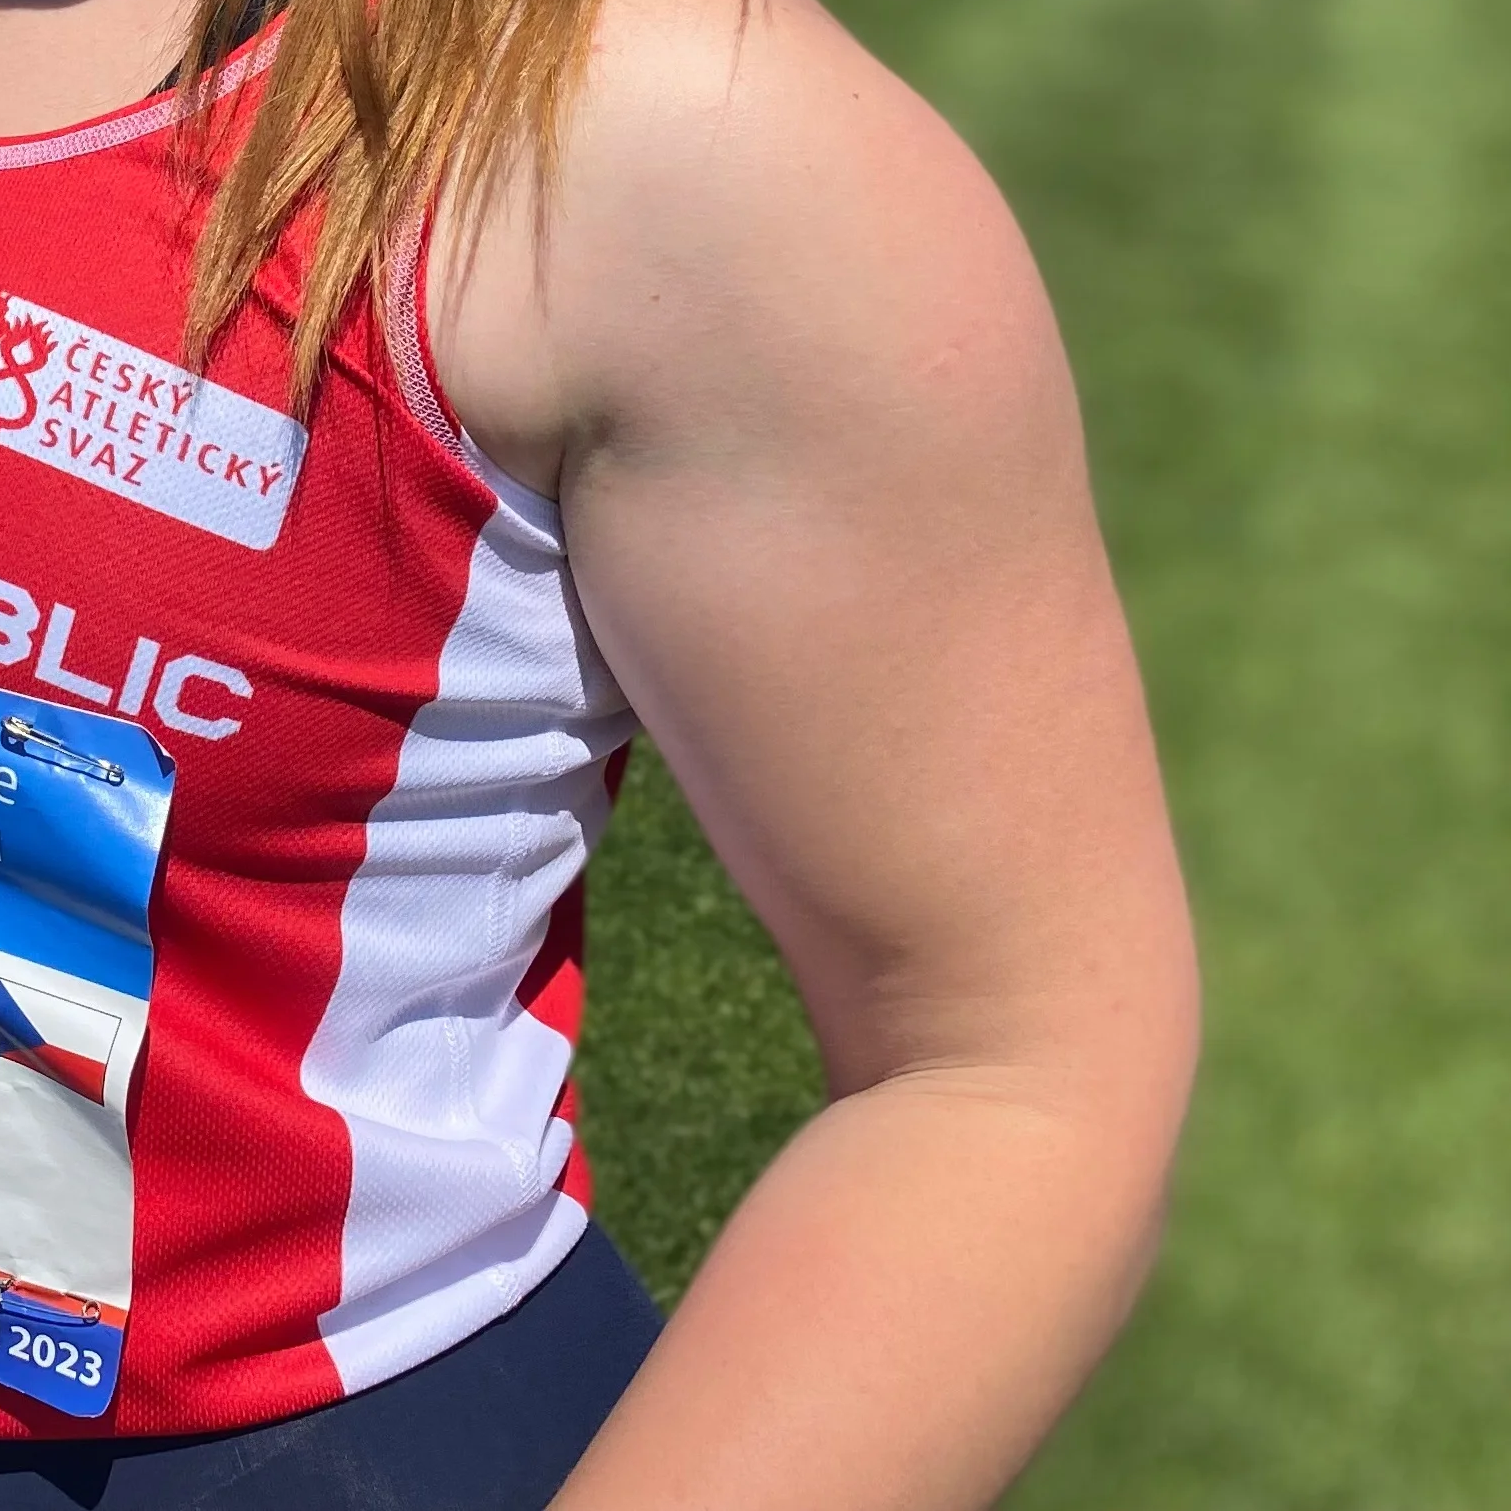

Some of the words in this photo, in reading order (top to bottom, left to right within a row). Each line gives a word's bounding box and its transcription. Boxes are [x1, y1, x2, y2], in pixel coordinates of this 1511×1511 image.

[64, 334, 193, 417] ČESKÝ
[39, 418, 149, 487] SVAZ
[48, 380, 284, 497] ATLETICKÝ
[8, 1325, 103, 1387] 2023
